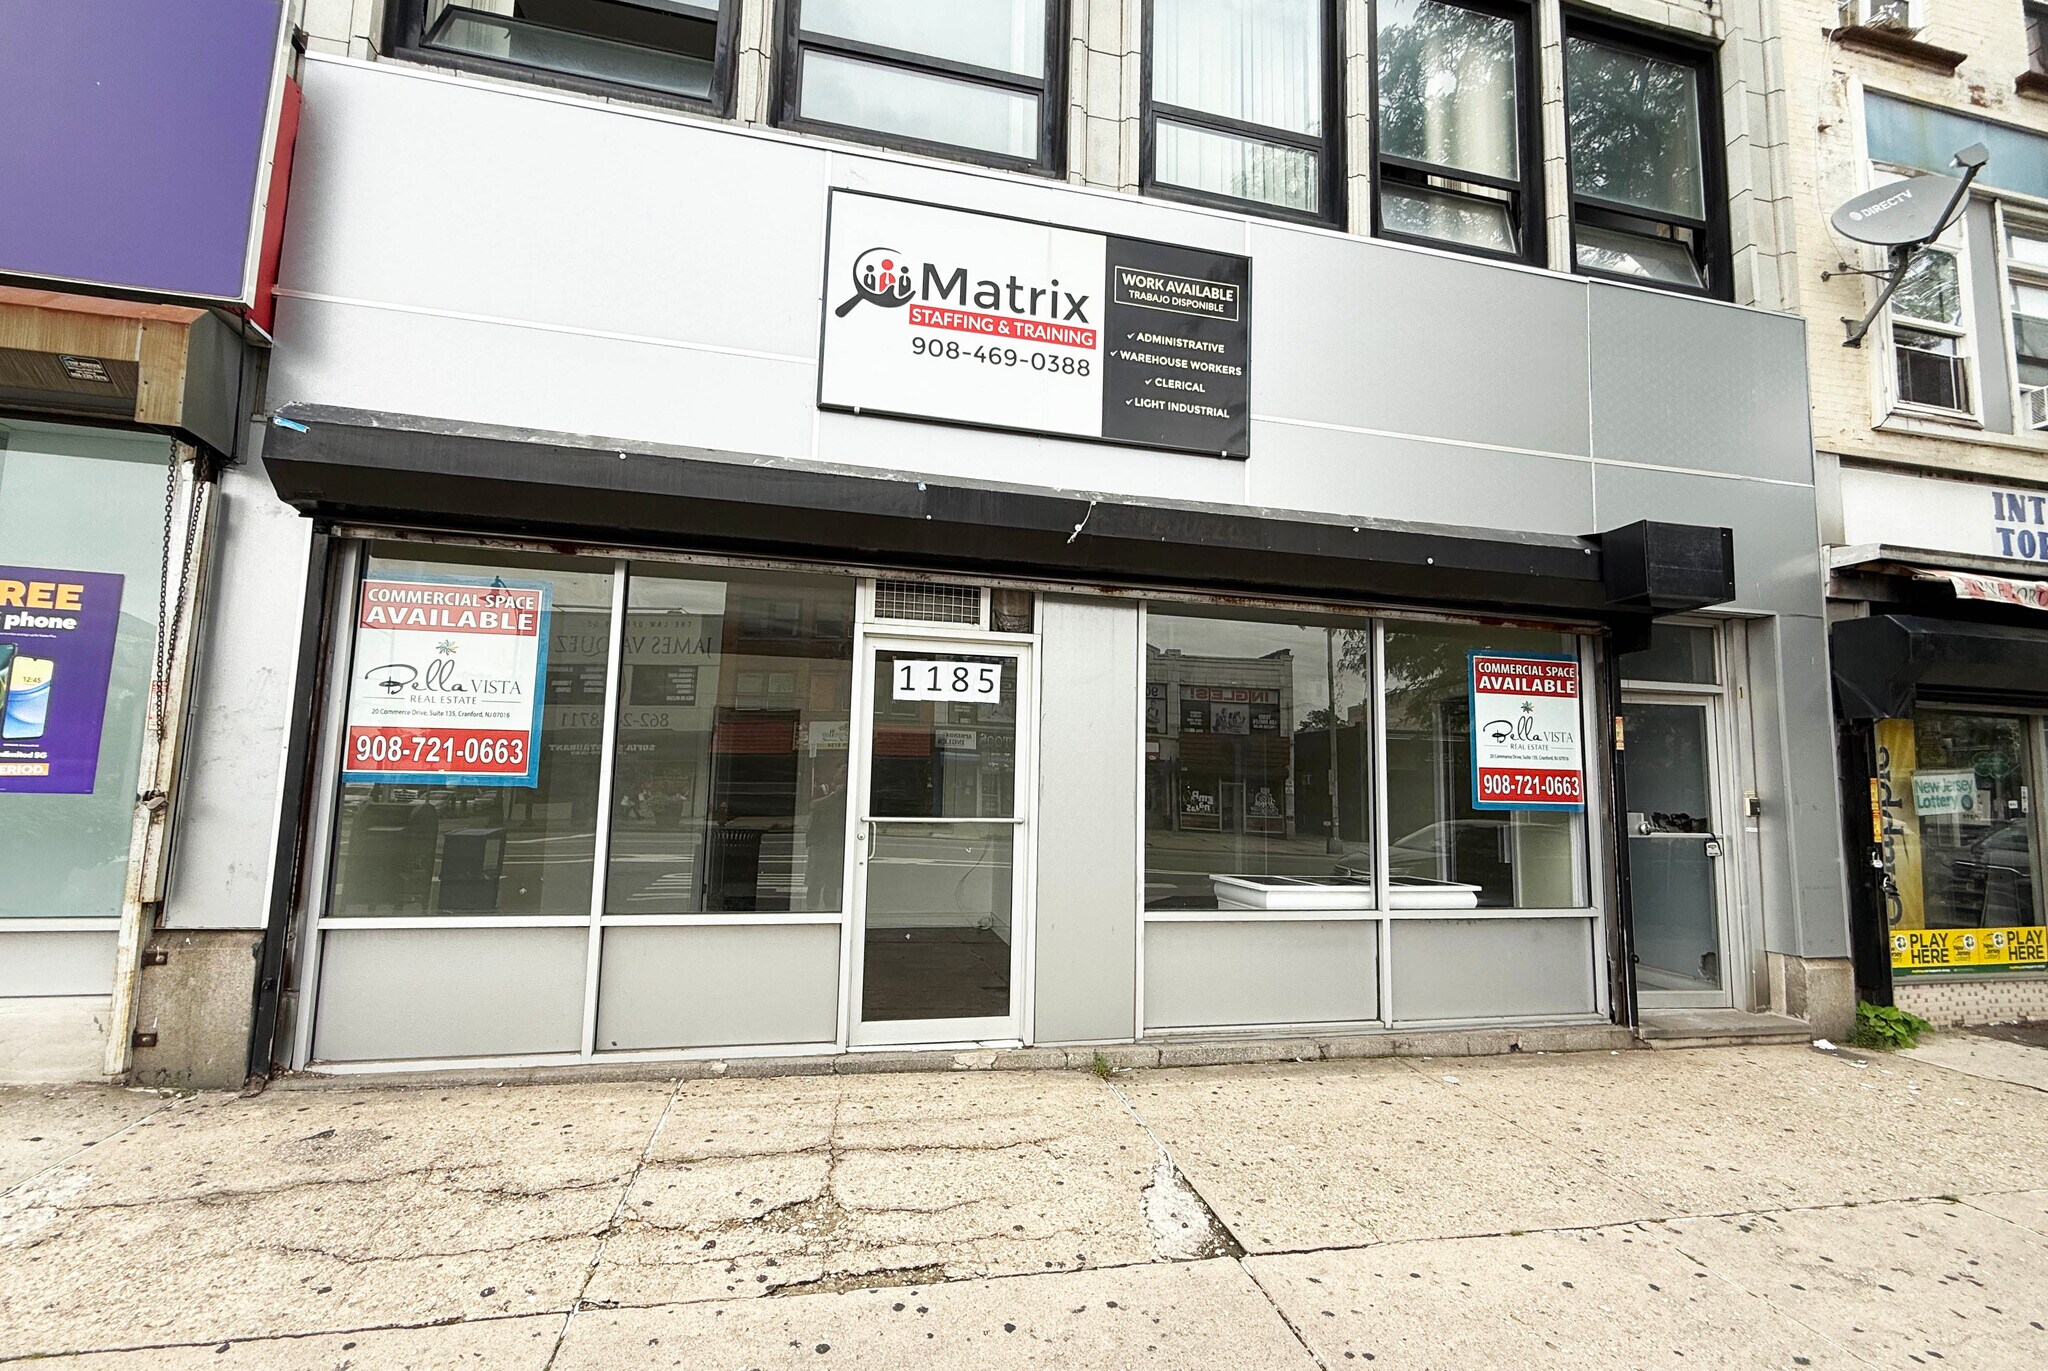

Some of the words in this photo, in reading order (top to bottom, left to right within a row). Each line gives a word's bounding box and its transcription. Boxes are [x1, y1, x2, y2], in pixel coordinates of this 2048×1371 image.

[1860, 189, 1913, 218] DIRECTV
[921, 263, 1090, 324] Matrix
[1121, 273, 1168, 293] WORK
[1166, 278, 1234, 302] AVAILABLE
[1128, 290, 1171, 305] TRABAJO
[1172, 295, 1224, 313] DISPONIBLE
[911, 308, 994, 334] STAFFING
[998, 320, 1010, 335] &
[1014, 322, 1093, 347] TRAINING
[1136, 332, 1225, 354] ADMINISTRATIVE
[911, 336, 1092, 378] 908-469-0388
[1120, 350, 1188, 370] WAREHOUSE
[1190, 358, 1242, 376] WORKERS
[1154, 378, 1206, 394] CLERICAL
[1134, 398, 1165, 411] LIGHT
[1167, 401, 1230, 419] INDUSTRIAL
[1992, 491, 2046, 525] INT
[368, 588, 480, 607] COMMERCIAL
[485, 594, 535, 610] SPACE
[4, 611, 77, 630] phone
[366, 606, 534, 631] AVAILABLE
[364, 659, 468, 695] Bella
[471, 680, 522, 695] VISTA
[900, 665, 994, 694] 1185
[1478, 662, 1544, 676] COMMERCIAL
[1546, 666, 1575, 678] SPACE
[1479, 675, 1576, 694] AVAILABLE
[410, 695, 436, 704] REAL
[440, 695, 478, 705] ESTATE
[380, 708, 411, 716] Commerce
[412, 709, 429, 717] Drive,
[458, 710, 484, 719] Cranford,
[1483, 715, 1543, 743] Bella
[1543, 731, 1574, 743] VISTA
[356, 735, 524, 764] 908-721-0663
[1483, 774, 1580, 796] 908-721-0663
[1914, 779, 1940, 794] New
[1942, 778, 1974, 798] Jersey
[1917, 795, 1959, 811] Lottery
[1910, 932, 1949, 948] PLAY
[2007, 929, 2043, 945] PLAY
[1911, 948, 1950, 964] HERE
[2008, 945, 2045, 961] HERE
